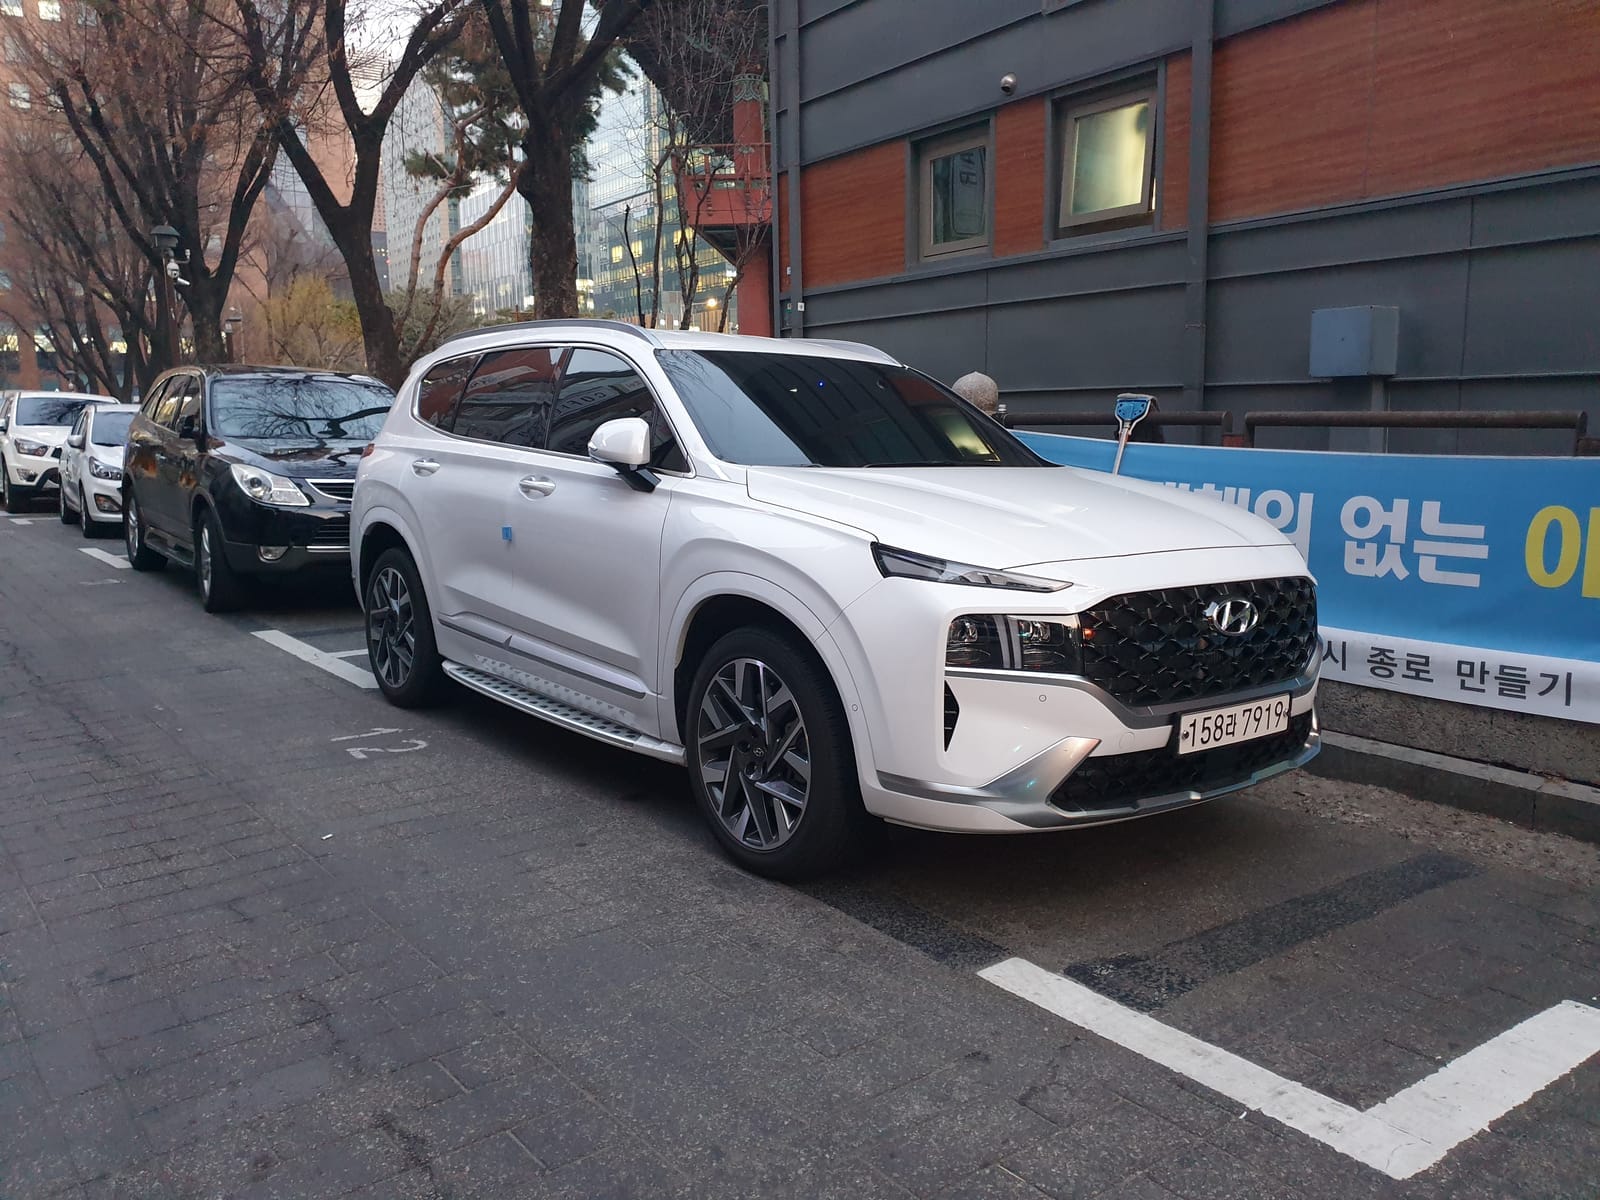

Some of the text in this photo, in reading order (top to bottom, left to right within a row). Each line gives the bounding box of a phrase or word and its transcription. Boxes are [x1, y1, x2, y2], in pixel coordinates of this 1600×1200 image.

[1340, 495, 1489, 588] 없는
[1323, 640, 1572, 706] 시 종로 만들기
[1189, 701, 1284, 747] 158라 7919
